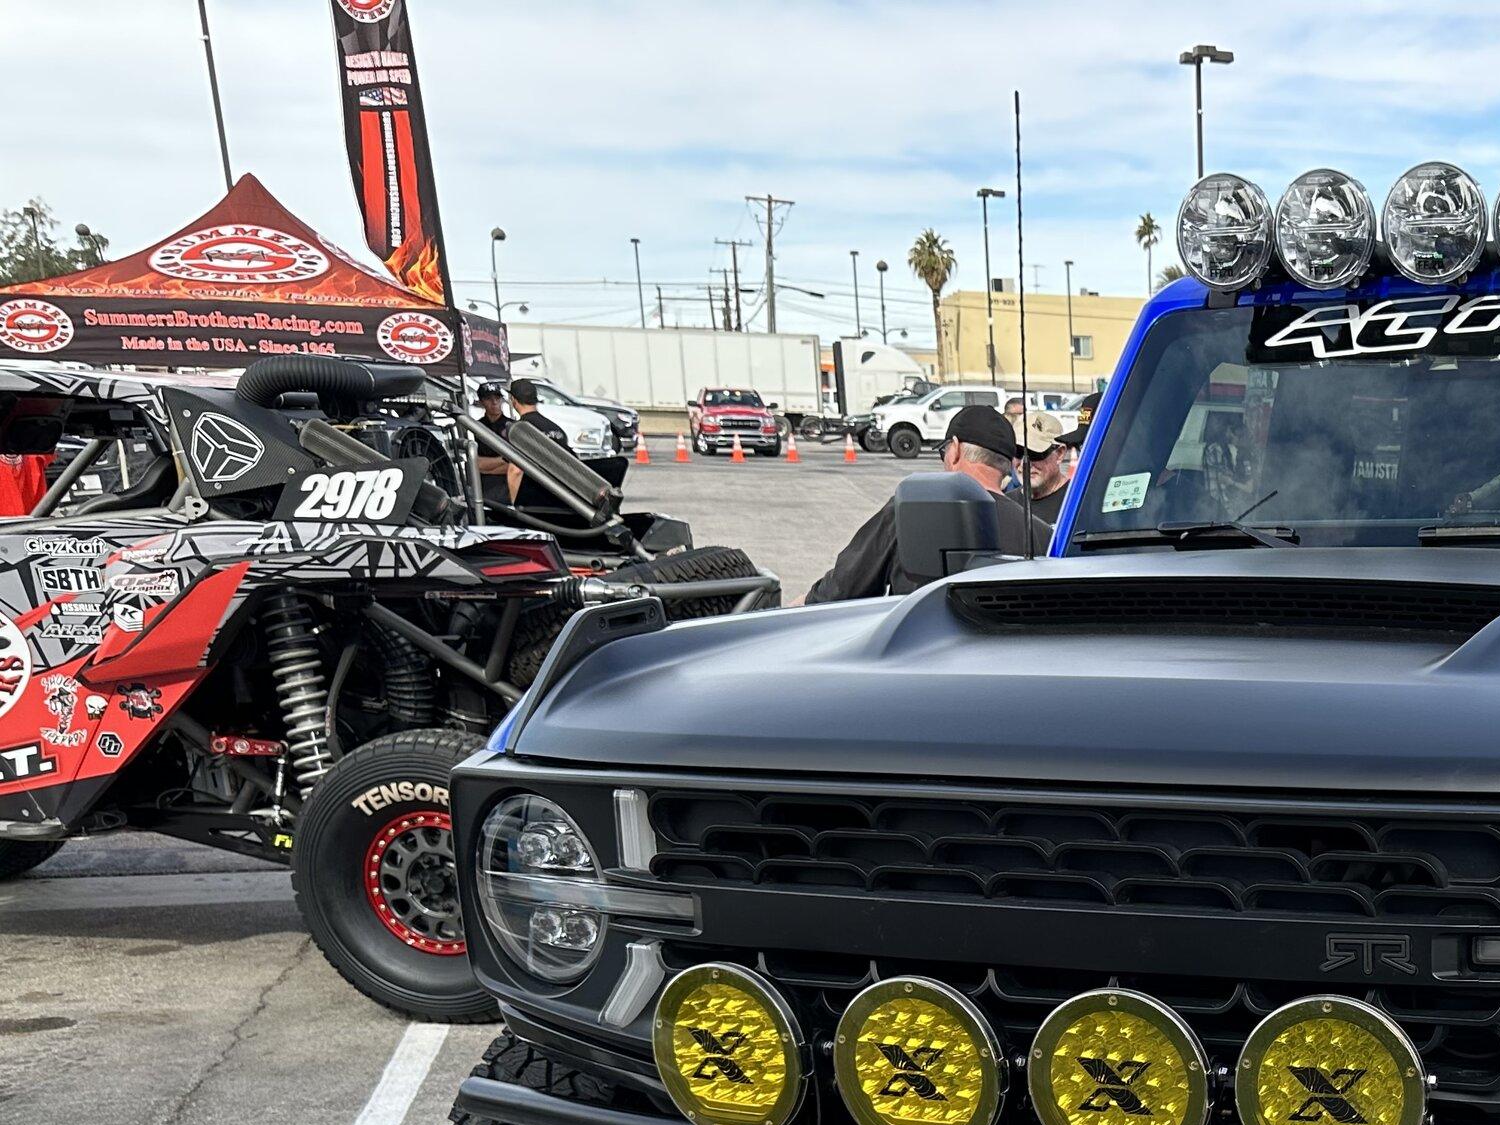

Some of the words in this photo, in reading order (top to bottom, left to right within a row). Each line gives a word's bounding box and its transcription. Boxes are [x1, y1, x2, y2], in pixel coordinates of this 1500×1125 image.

[161, 227, 322, 261] SUMMERS
[157, 262, 317, 281] BROTHERS
[83, 309, 364, 336] SummersBrothersRacing.com
[381, 314, 449, 337] SUMMERS
[121, 336, 165, 351] Made
[167, 338, 184, 351] in
[186, 338, 211, 352] the
[213, 339, 248, 352] USA
[258, 340, 297, 354] Since
[299, 340, 336, 354] 1965
[383, 342, 449, 363] BROTHERS
[294, 468, 403, 520] 2978
[26, 537, 105, 556] GlazzKraft
[43, 568, 100, 591] SBTH
[62, 602, 101, 612] ASSAULT
